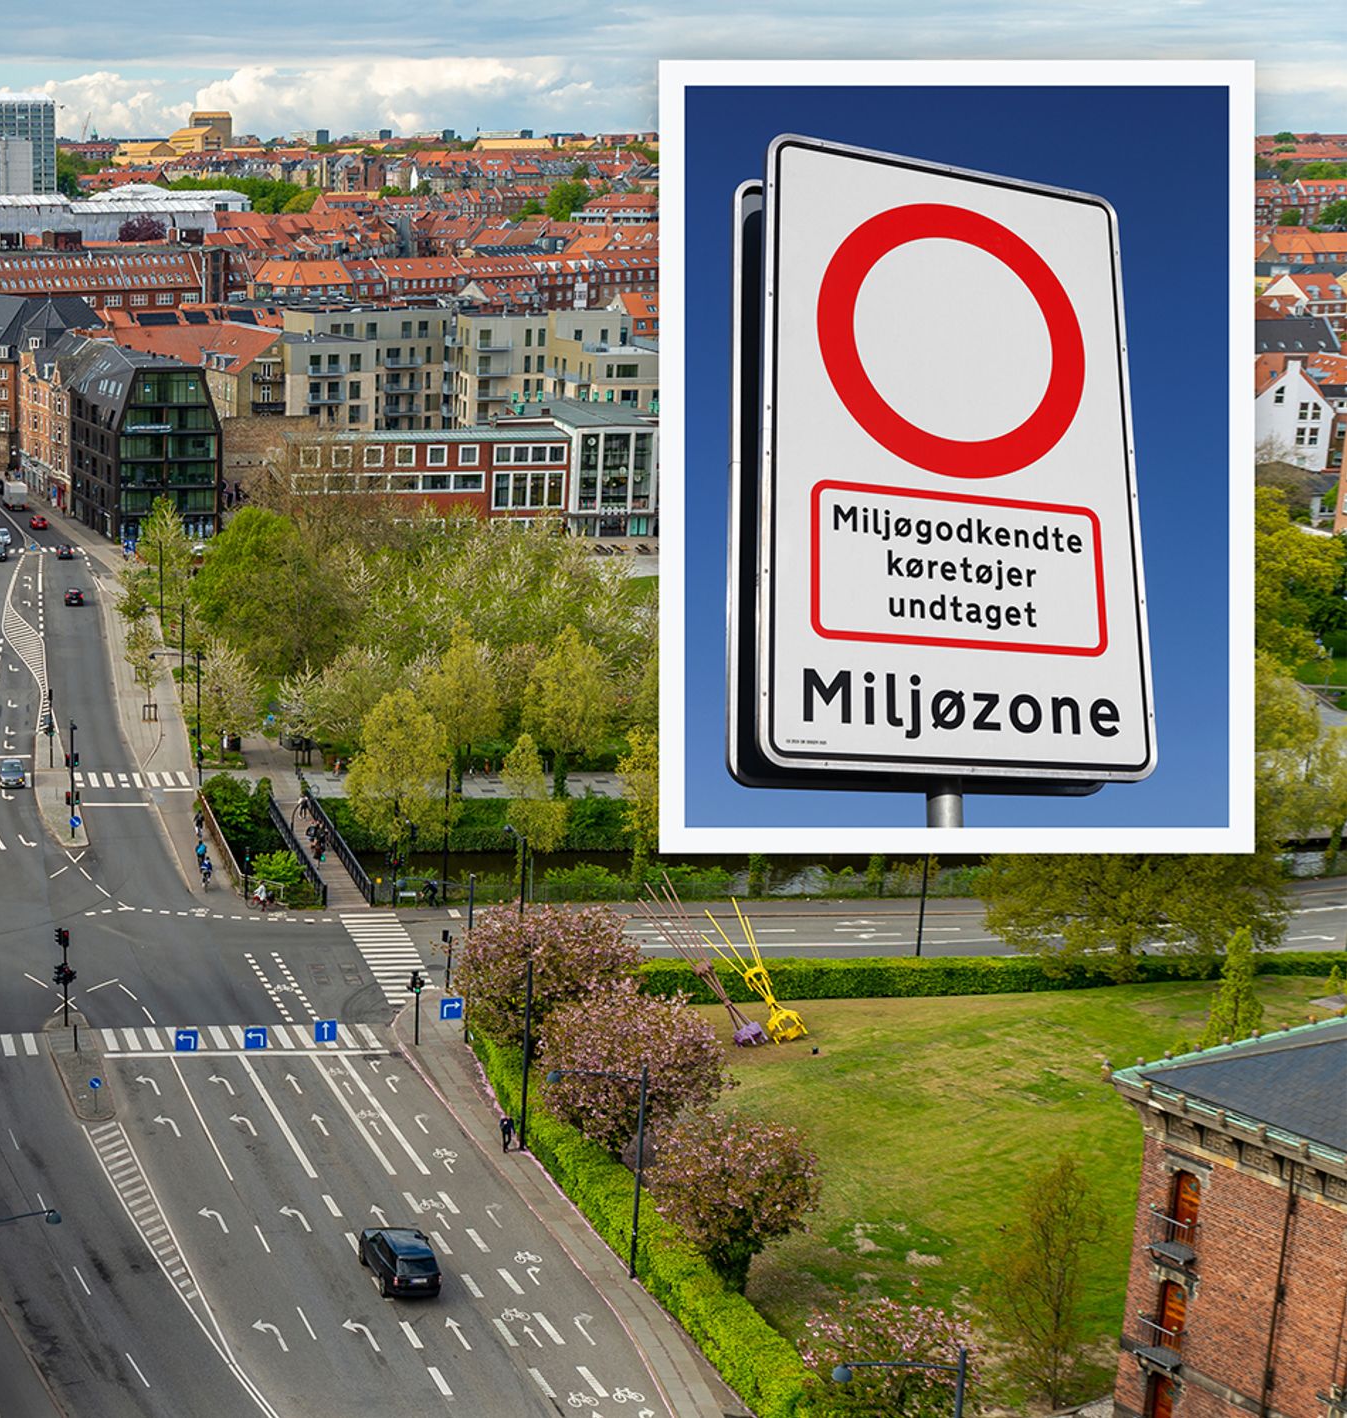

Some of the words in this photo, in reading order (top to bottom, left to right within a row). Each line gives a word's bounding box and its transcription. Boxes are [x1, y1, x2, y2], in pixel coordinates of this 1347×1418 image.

[834, 505, 1082, 553] Miljøgodkendte
[888, 550, 1036, 590] køretøjer
[890, 595, 1036, 630] undtaget
[804, 668, 1119, 739] Miljøzone
